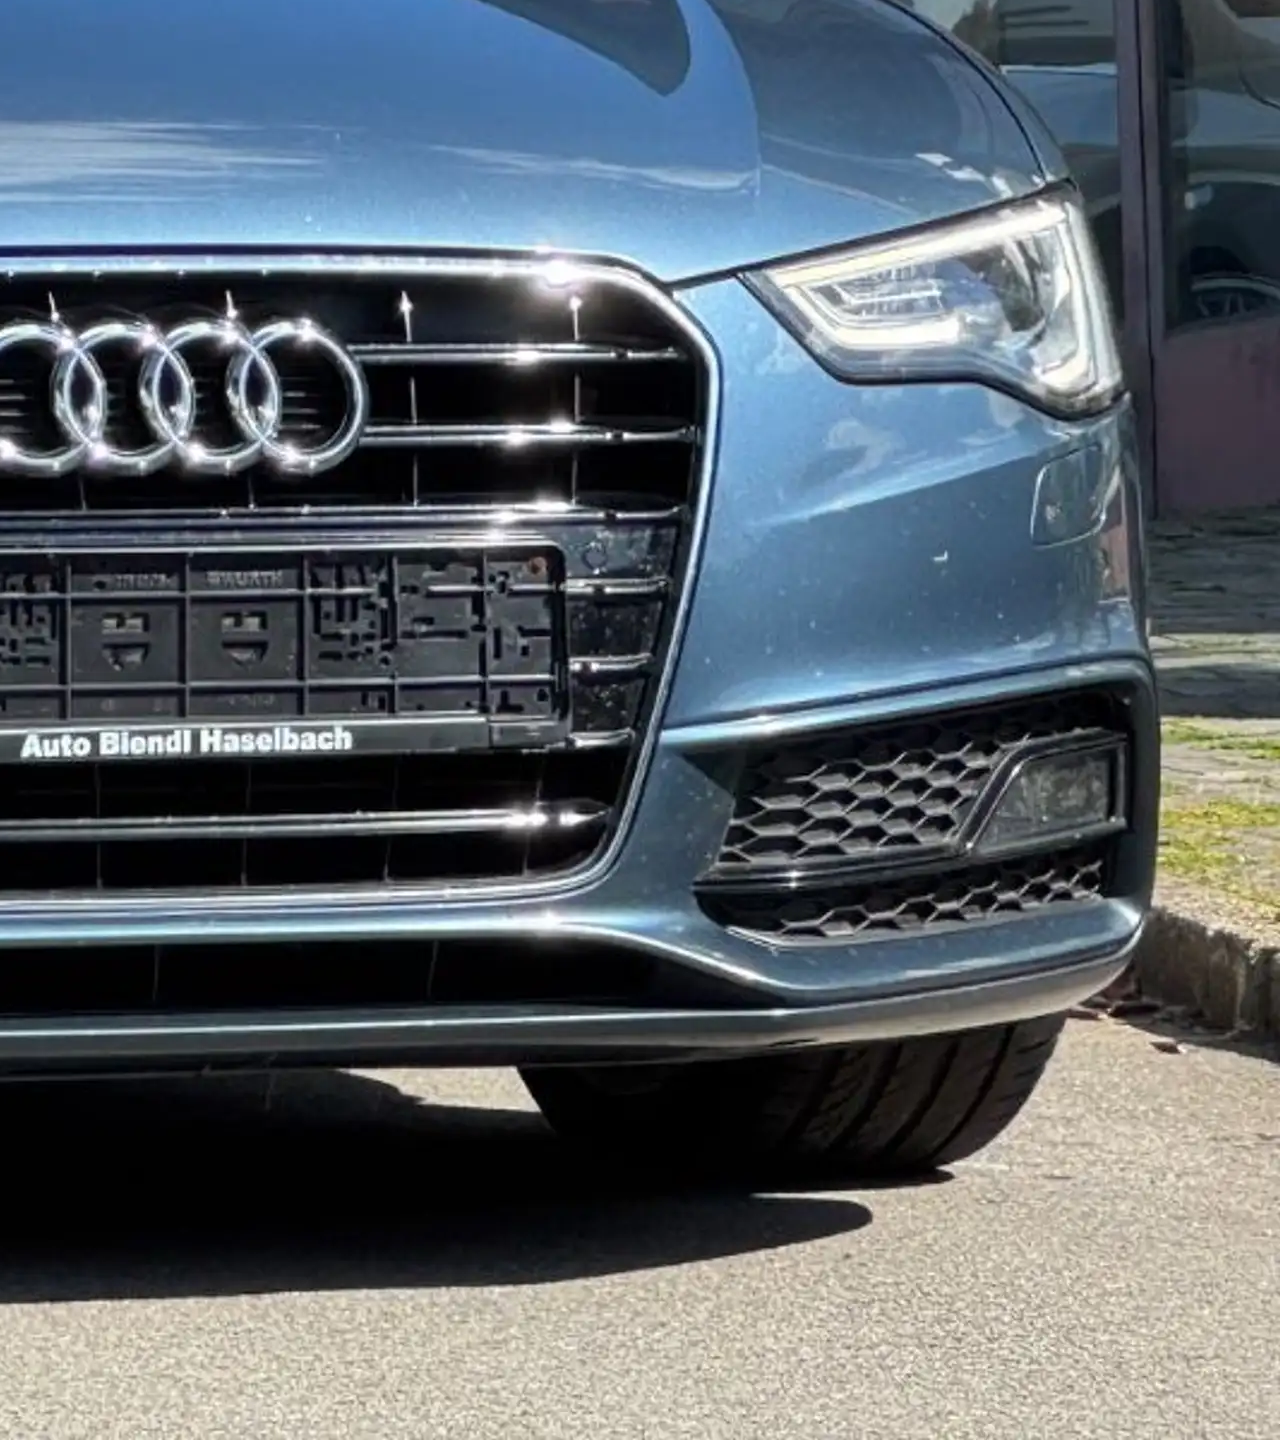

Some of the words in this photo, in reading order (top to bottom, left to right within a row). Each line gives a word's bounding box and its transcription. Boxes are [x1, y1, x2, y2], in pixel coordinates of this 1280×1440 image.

[20, 733, 91, 759] Auto
[99, 729, 191, 756] Biendl
[200, 726, 353, 753] Haselbach
